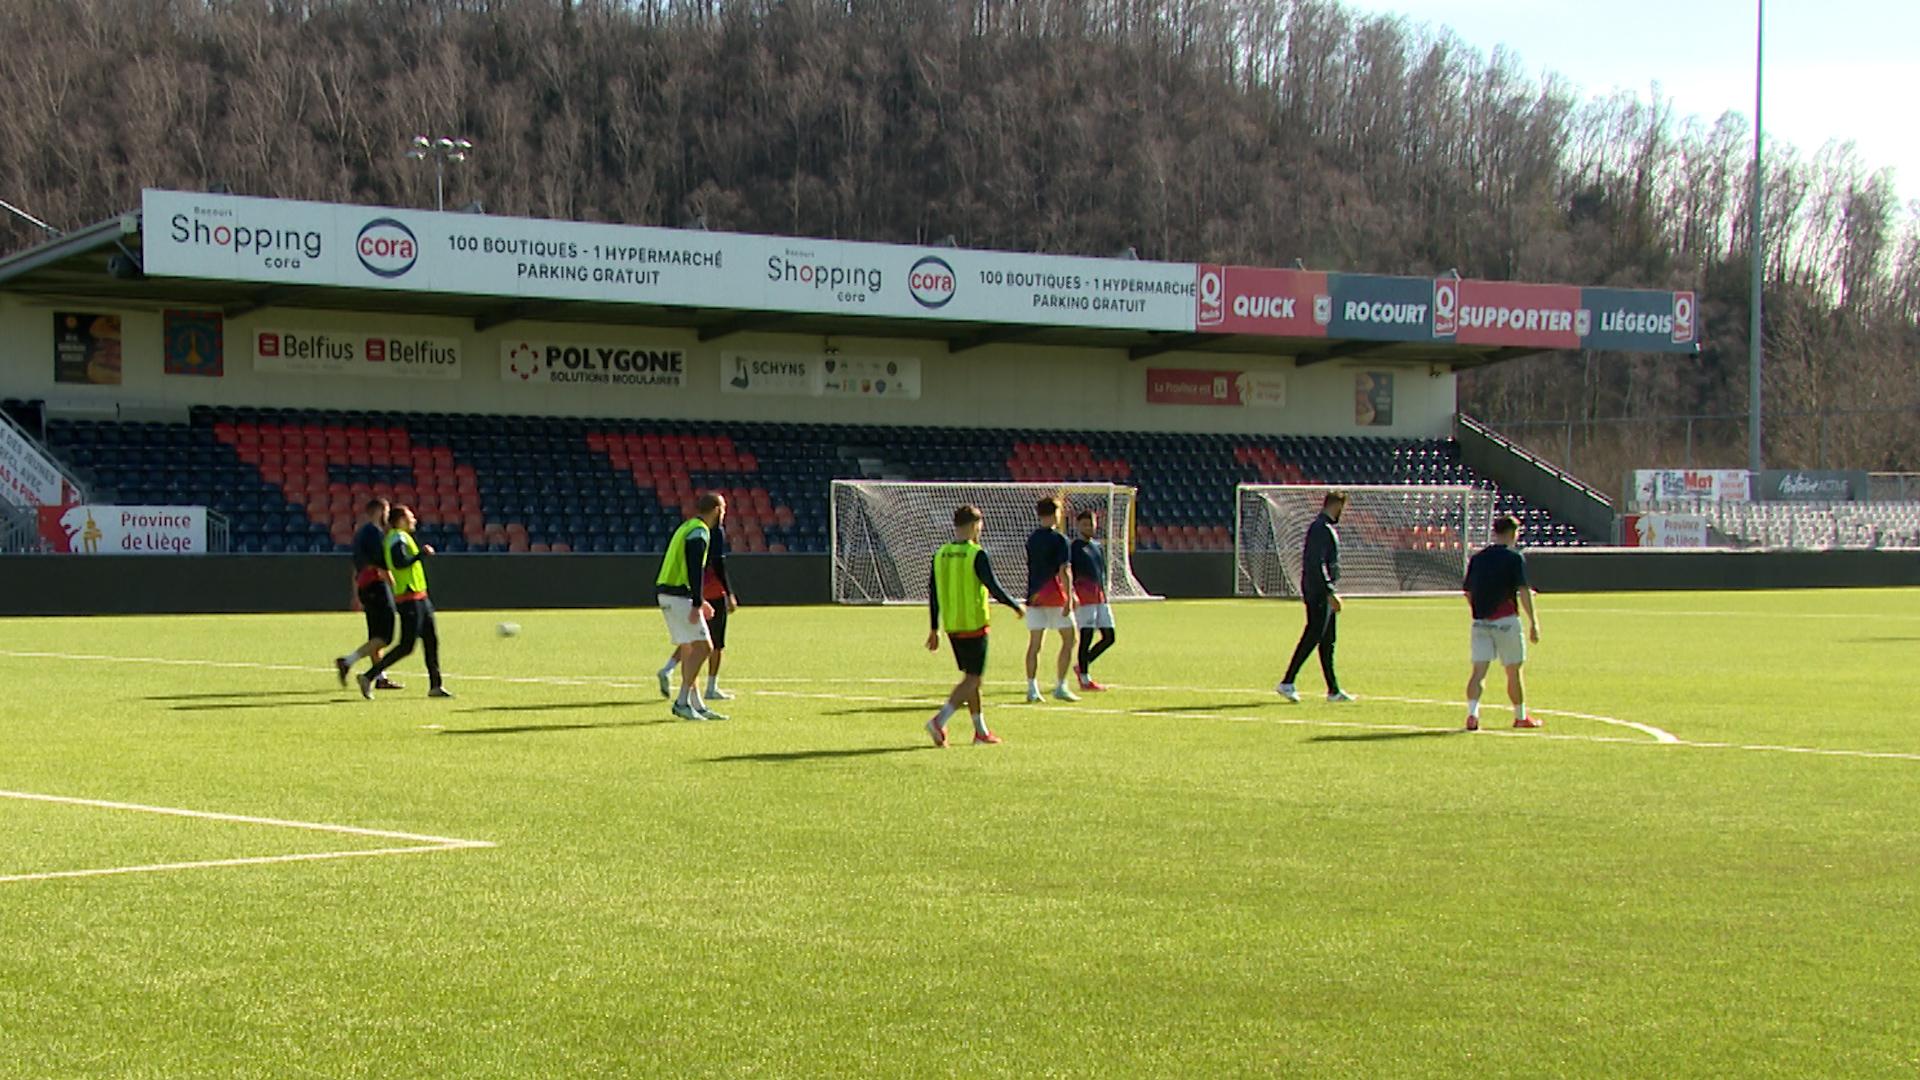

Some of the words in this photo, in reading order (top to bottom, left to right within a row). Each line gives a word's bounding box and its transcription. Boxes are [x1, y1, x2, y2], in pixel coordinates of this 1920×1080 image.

[171, 213, 322, 259] Shopping
[361, 235, 414, 258] cora
[264, 257, 301, 269] cora
[448, 235, 478, 251] 100
[484, 237, 577, 258] BOUTIQUES
[594, 245, 601, 259] 1
[606, 248, 723, 268] HYPERMARCHÉ
[517, 263, 588, 281] PARKING
[593, 268, 660, 285] GRATUIT
[768, 256, 882, 293] Shopping
[911, 272, 952, 292] cora
[980, 271, 1003, 284] 100
[1006, 273, 1081, 290] BOUTIQUES
[1094, 278, 1100, 290] 1
[837, 291, 866, 303] cora
[1033, 294, 1089, 310] PARKING
[1093, 297, 1146, 313] GRATUIT
[1233, 295, 1296, 319] QUICK
[1344, 301, 1428, 325] ROCOURT
[1459, 306, 1571, 332] SUPPORTER
[1600, 307, 1672, 334] LIÉGEOIS
[283, 333, 354, 361] Belfius
[389, 339, 457, 364] Belfius
[545, 345, 683, 373] POLYGONE
[752, 360, 806, 377] SCHYNS
[550, 371, 610, 384] SOLUTIONS
[121, 511, 192, 529] Province
[121, 535, 143, 551] de
[146, 534, 192, 553] Liège
